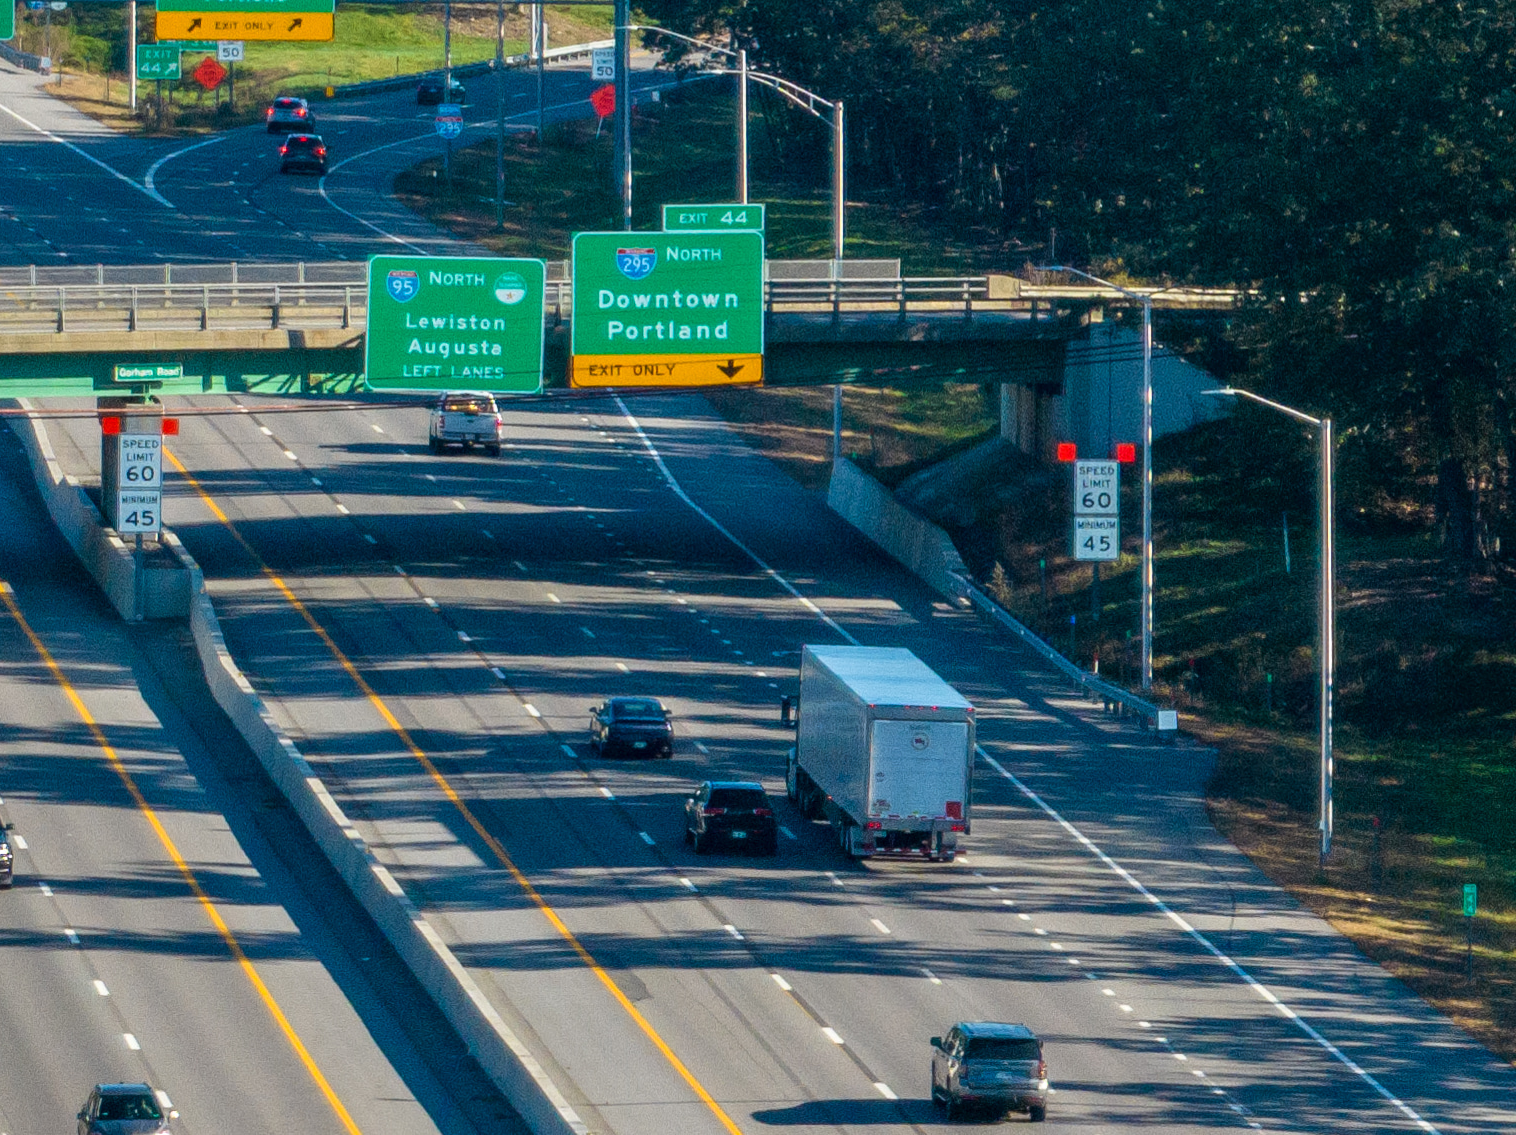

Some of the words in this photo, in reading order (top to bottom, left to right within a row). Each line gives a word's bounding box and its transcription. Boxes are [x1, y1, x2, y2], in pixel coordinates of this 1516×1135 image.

[215, 22, 238, 30] EXIT
[245, 22, 274, 30] ONLY
[146, 50, 172, 59] EXIT
[222, 48, 240, 58] 50
[141, 64, 161, 72] 44
[596, 66, 613, 76] 50
[439, 122, 460, 133] 295
[679, 213, 708, 224] EXIT
[720, 211, 748, 225] 44
[666, 246, 722, 262] NORTH
[623, 257, 650, 272] 295
[429, 272, 485, 286] NORTH
[392, 280, 414, 295] 95
[598, 289, 738, 309] Downtown
[406, 313, 506, 331] Lewiston
[608, 320, 728, 340] Portland
[408, 338, 502, 359] Augusta
[119, 368, 154, 377] Gorham
[157, 367, 180, 376] Road
[403, 365, 441, 378] LEFT
[451, 366, 504, 379] LANES
[588, 364, 622, 376] EXIT
[634, 364, 676, 376] ONLY
[122, 440, 159, 448] SPEED
[126, 453, 154, 462] LIMIT
[126, 466, 154, 482] 60
[1079, 466, 1114, 476] SPEED
[1082, 480, 1111, 488] LIMIT
[122, 496, 158, 504] MINIMUM
[1082, 492, 1111, 508] 60
[125, 510, 154, 526] 45
[1078, 521, 1116, 529] MINIMUM
[1084, 536, 1110, 552] 45
